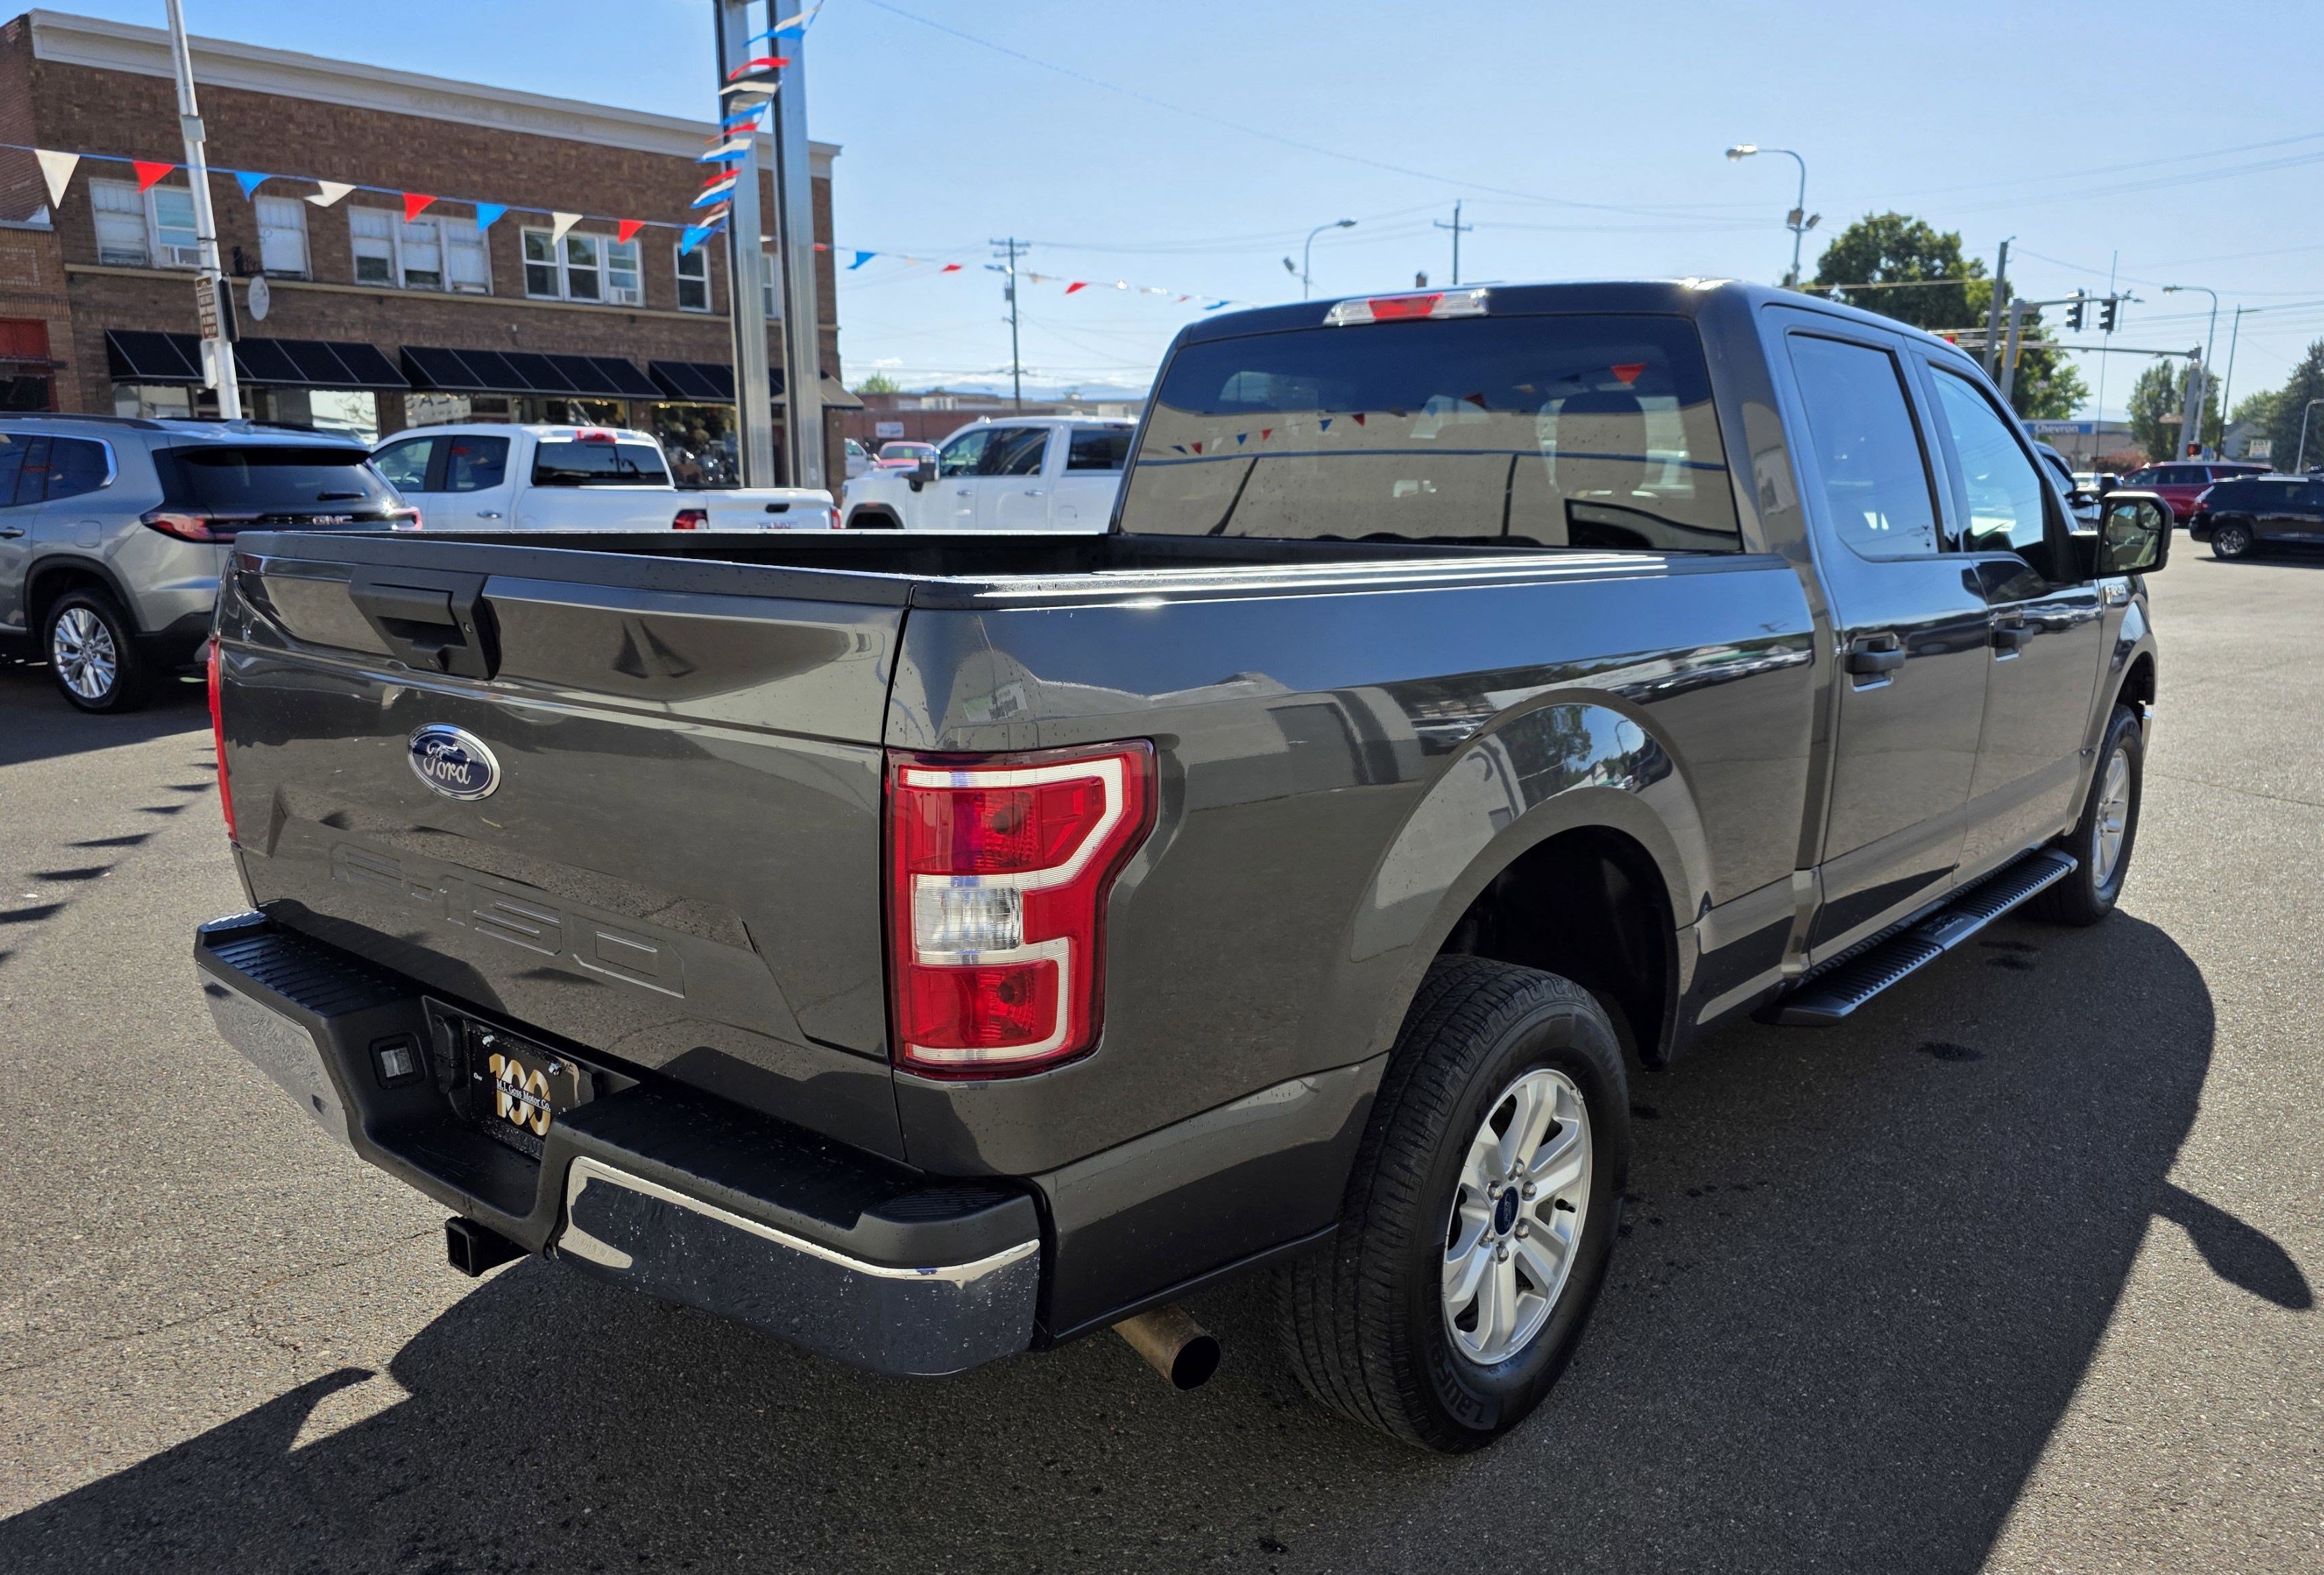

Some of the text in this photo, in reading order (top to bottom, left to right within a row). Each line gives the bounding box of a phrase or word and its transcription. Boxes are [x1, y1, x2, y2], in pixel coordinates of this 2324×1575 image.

[2034, 423, 2079, 434] Chevron
[312, 515, 353, 525] GMC
[423, 740, 472, 785] Ford
[329, 842, 685, 998] F-150
[489, 1052, 551, 1136] 100
[496, 1079, 508, 1092] M.J.
[508, 1085, 523, 1098] Goss
[523, 1091, 541, 1106] Motor
[541, 1099, 551, 1111] Co.
